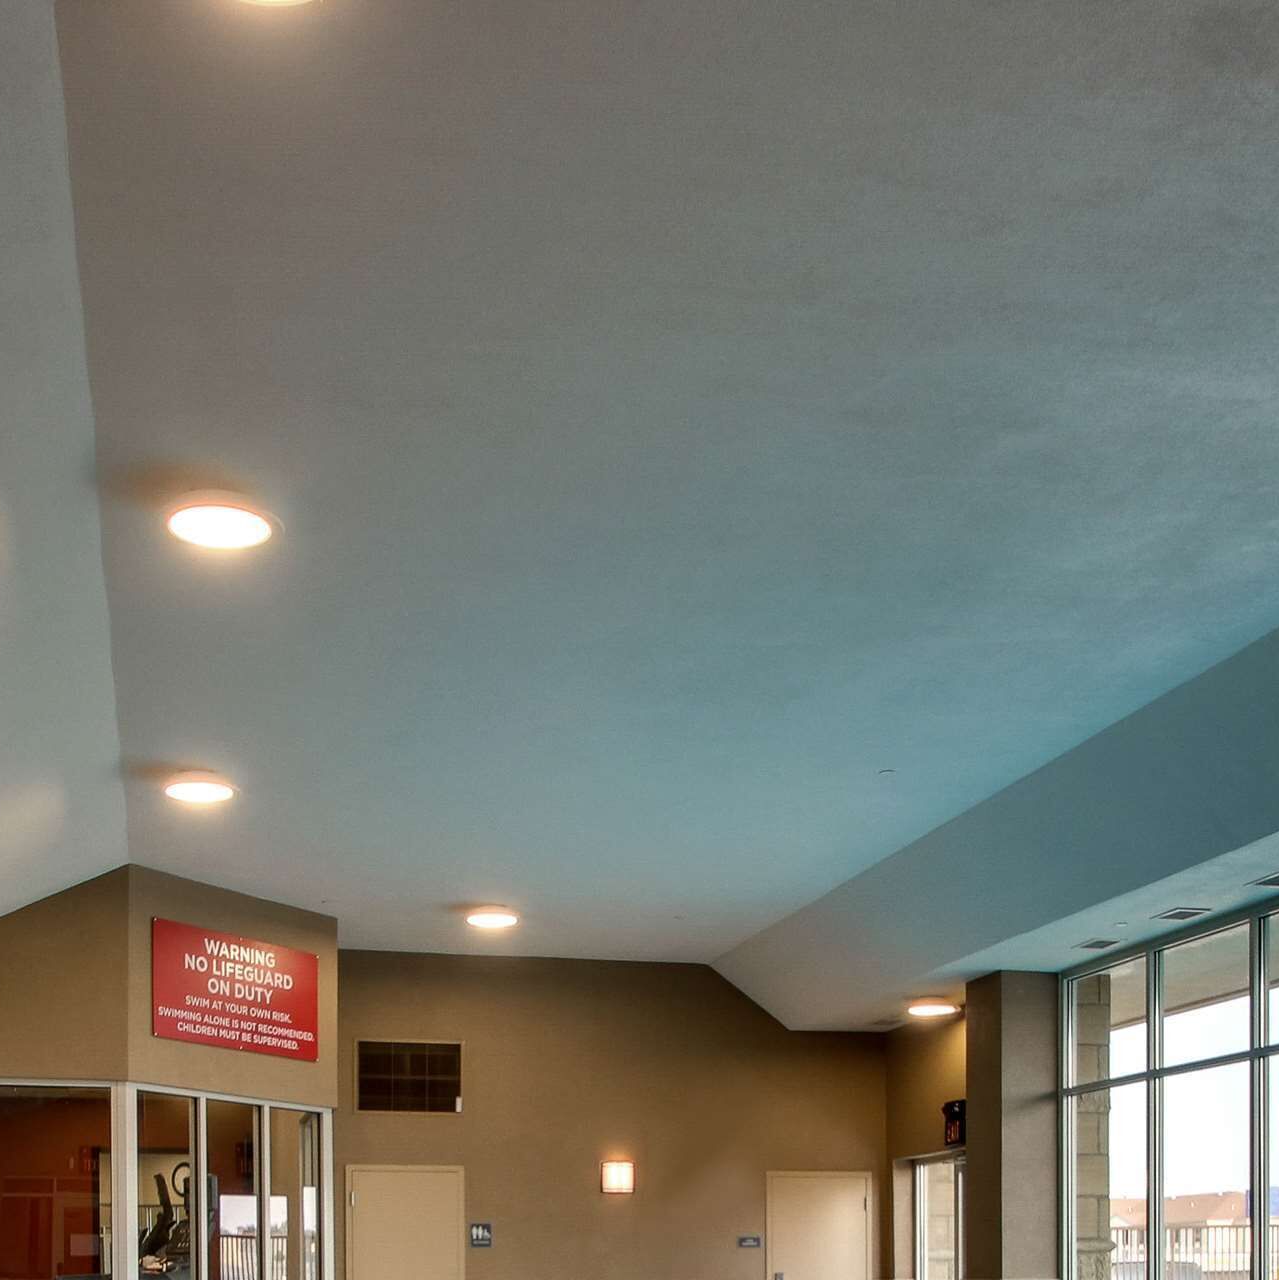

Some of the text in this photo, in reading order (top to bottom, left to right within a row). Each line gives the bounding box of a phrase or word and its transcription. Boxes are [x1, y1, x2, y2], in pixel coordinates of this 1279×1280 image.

[204, 938, 276, 968] WARNING
[184, 953, 293, 990] NO LIFEGUARD
[207, 978, 273, 1005] ON DUTY
[158, 1006, 315, 1042] SWIMMING ALONE IS NOT RECOMMENDED.
[185, 995, 292, 1024] SWIM AT YOUR OWN RISK.
[177, 1022, 299, 1050] CHILDREN MUST BE SUPERVISED.
